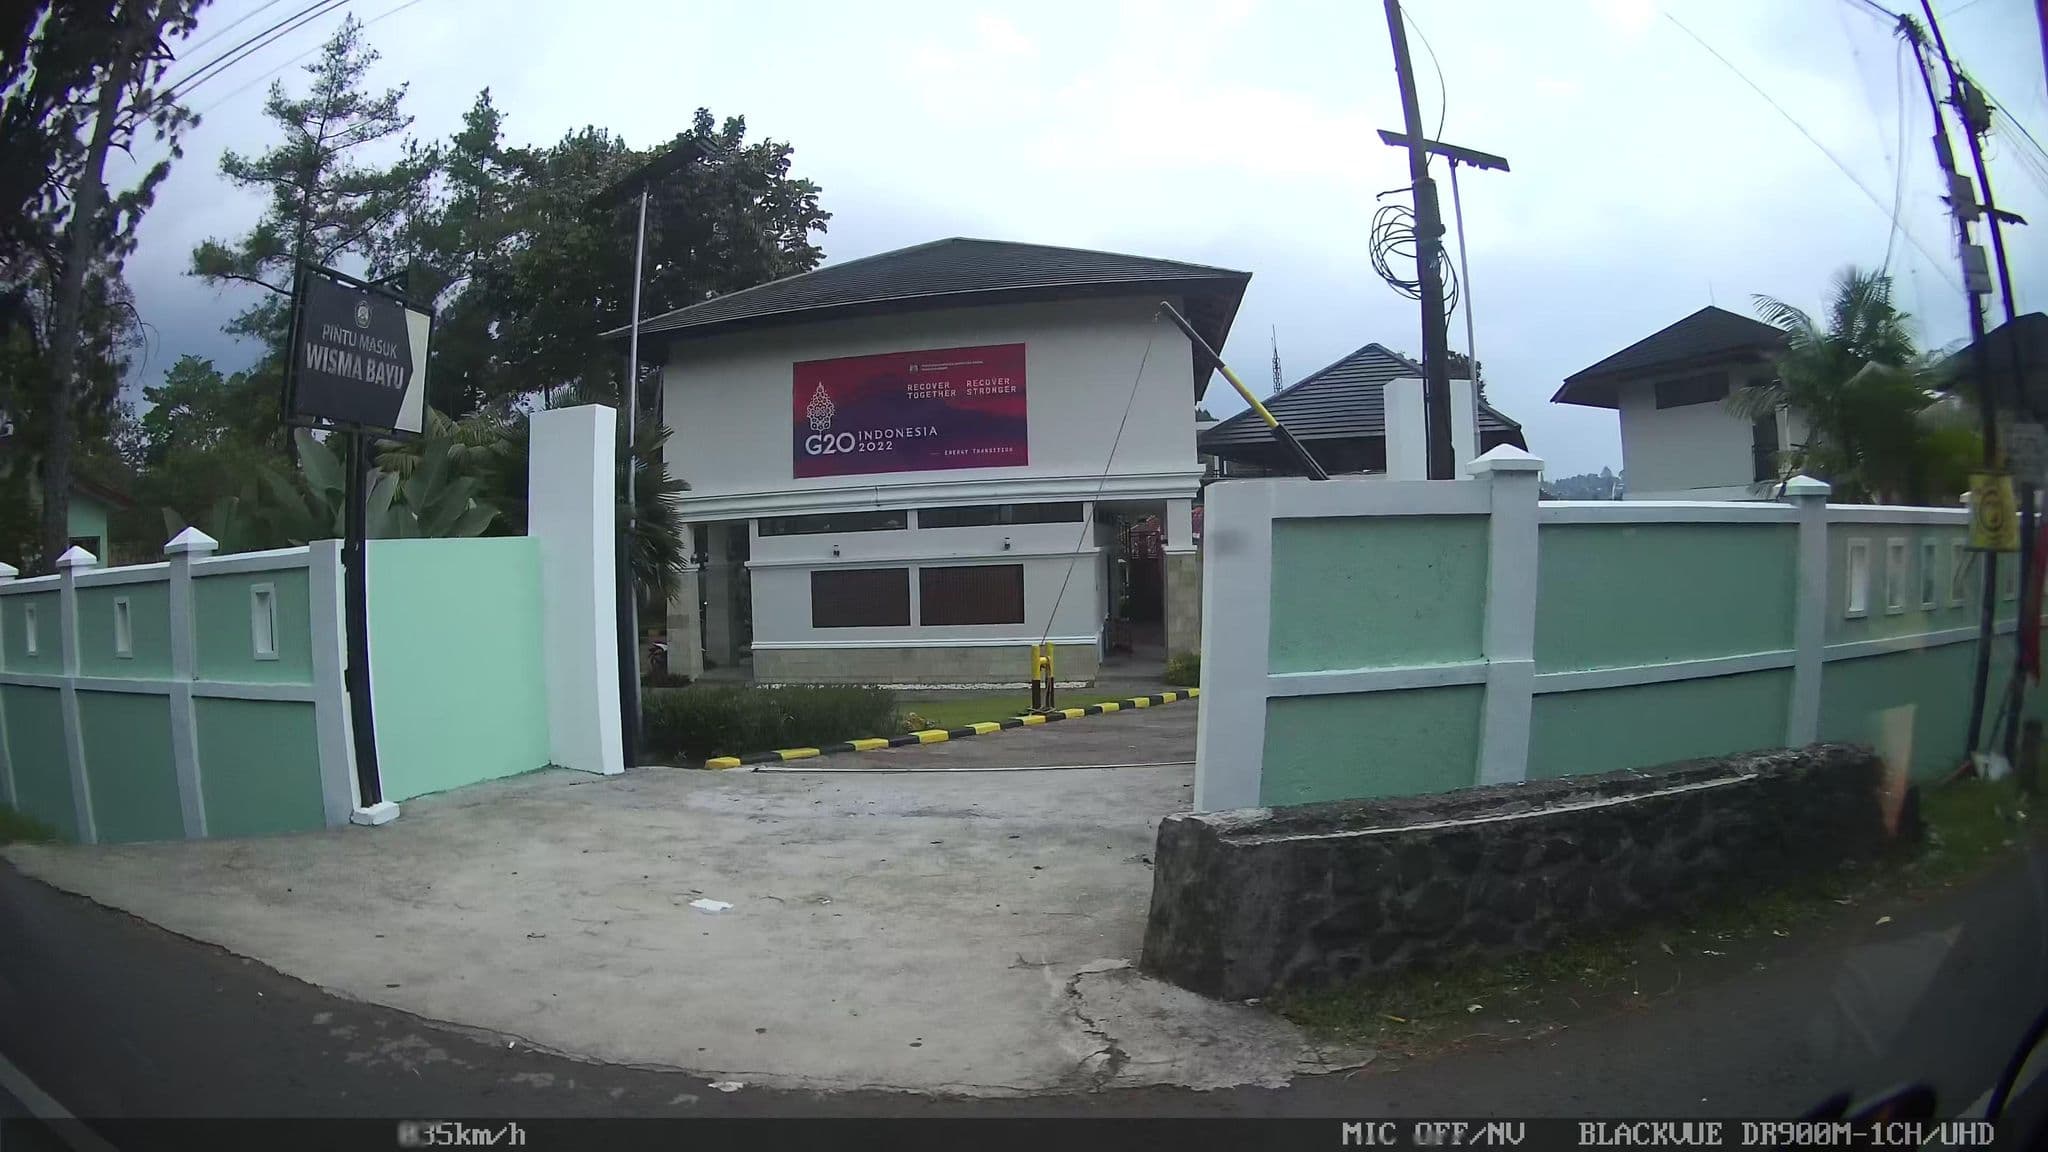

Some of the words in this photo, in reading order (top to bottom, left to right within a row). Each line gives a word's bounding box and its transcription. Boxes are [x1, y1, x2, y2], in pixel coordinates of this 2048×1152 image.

[322, 324, 357, 346] PINTU
[359, 334, 397, 359] MASUK
[306, 342, 363, 380] WISMA
[366, 357, 404, 389] BAYU
[907, 381, 950, 391] RECOVER
[966, 378, 1010, 387] RECOVER
[907, 389, 956, 399] TOGETHER
[966, 386, 1017, 395] STRONGER
[858, 426, 938, 441] INDONESIA
[805, 432, 856, 455] G20
[858, 441, 893, 452] 2022
